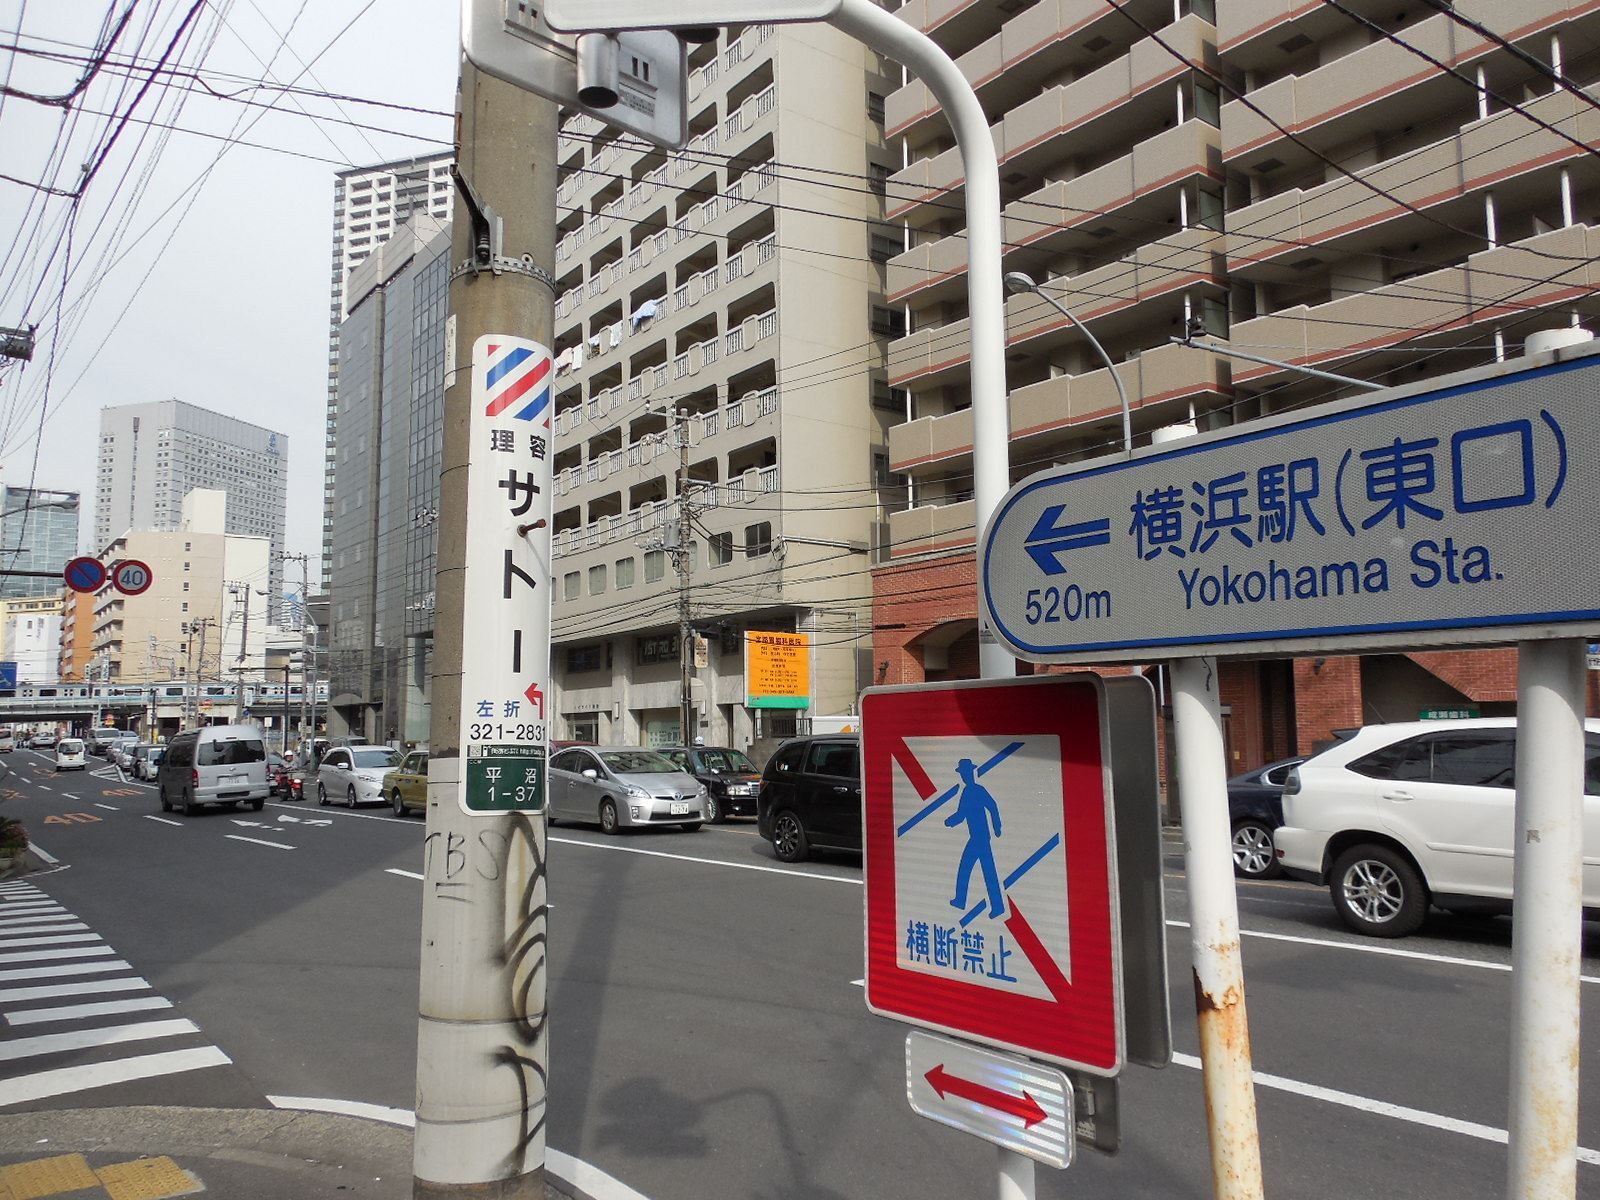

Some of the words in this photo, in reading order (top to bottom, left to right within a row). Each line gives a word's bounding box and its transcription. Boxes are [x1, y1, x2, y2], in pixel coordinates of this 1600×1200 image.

[490, 429, 546, 462] 理容
[1129, 410, 1567, 561] 横浜駅(東口)
[121, 570, 143, 586] 40
[498, 468, 541, 674] サトー
[1178, 556, 1390, 610] Yokohama
[1409, 535, 1504, 590] Sta.
[1024, 585, 1112, 625] 520m
[476, 699, 521, 718] 左折
[470, 723, 546, 742] 321-2831
[486, 767, 537, 784] 平沼
[487, 786, 536, 802] 1-37
[906, 919, 1018, 984] 横断禁止
